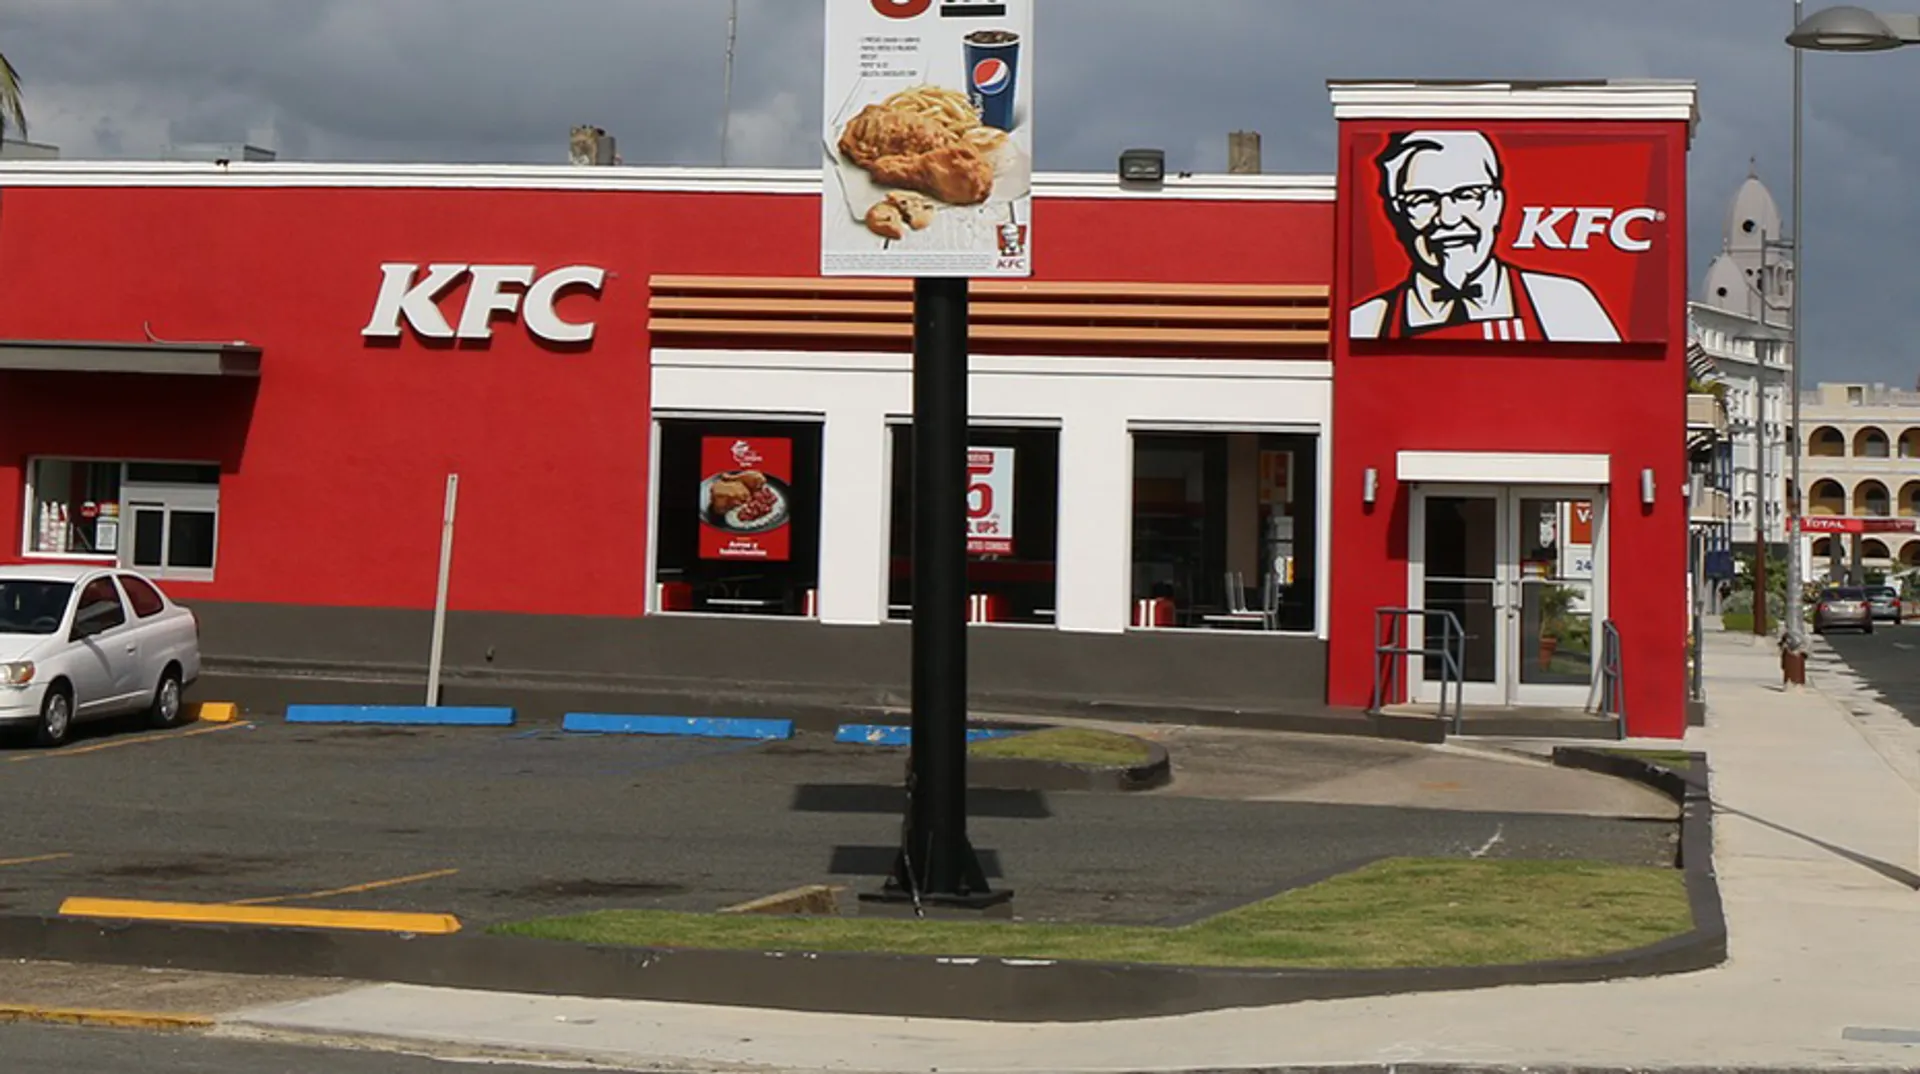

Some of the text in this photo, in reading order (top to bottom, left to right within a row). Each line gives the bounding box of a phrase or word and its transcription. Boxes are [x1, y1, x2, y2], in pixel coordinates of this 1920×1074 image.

[1512, 207, 1656, 250] KFC
[996, 259, 1024, 269] KFC
[361, 263, 605, 342] KFC
[1805, 520, 1845, 529] TOTAL
